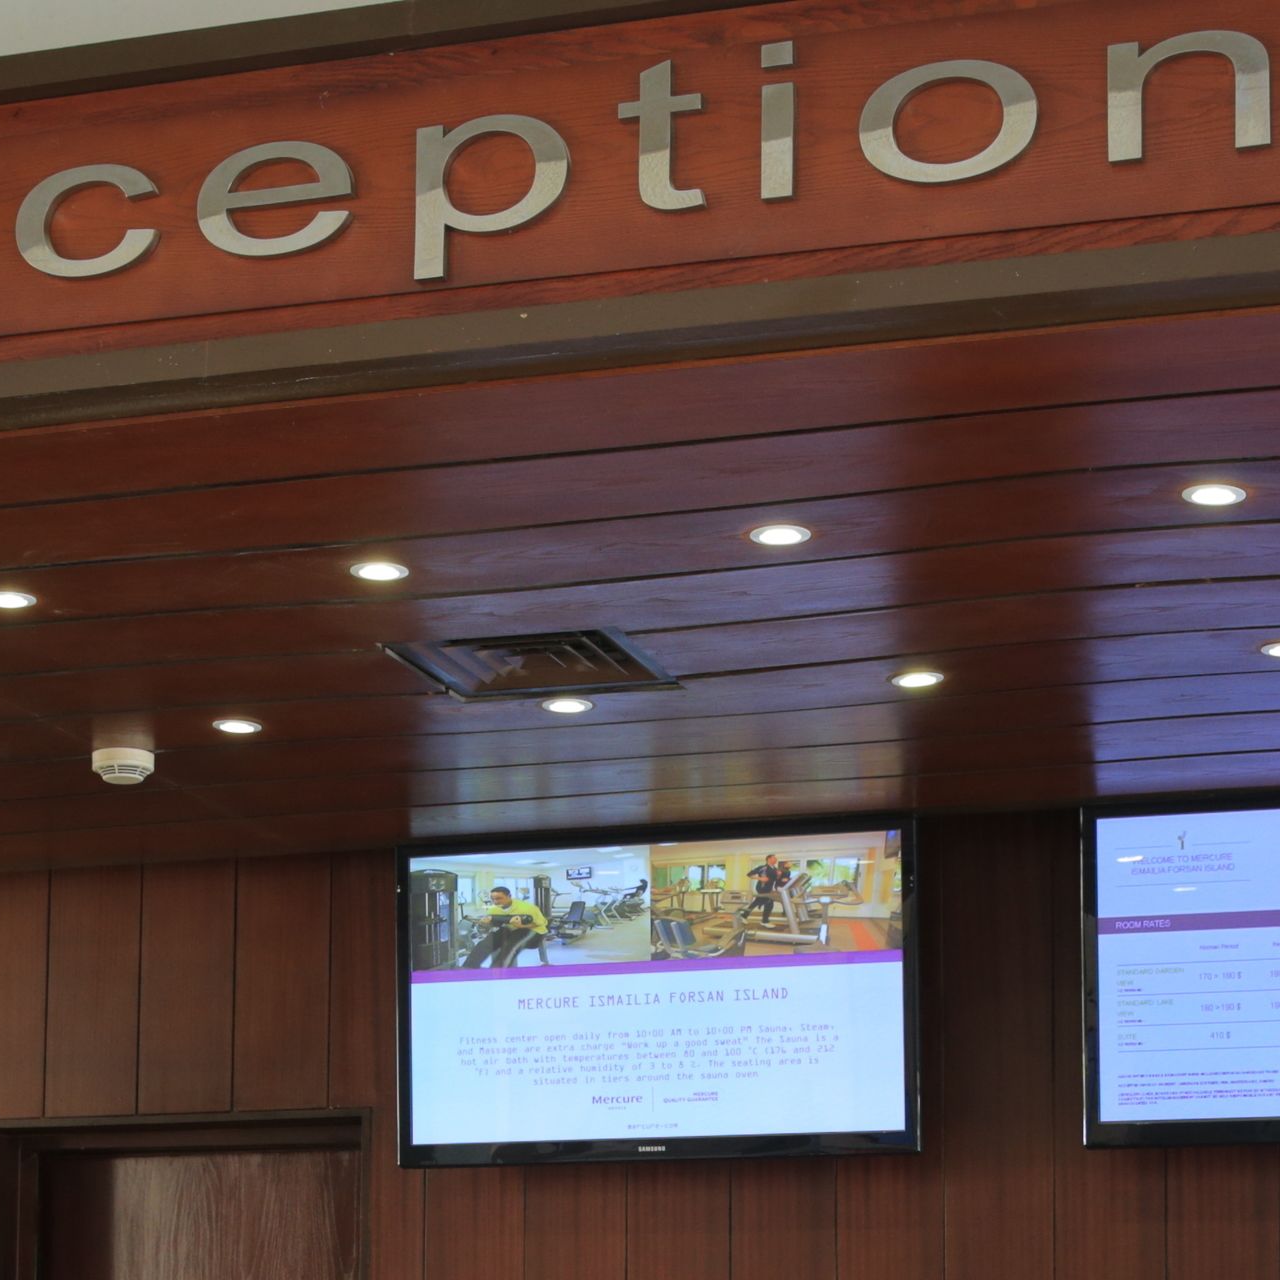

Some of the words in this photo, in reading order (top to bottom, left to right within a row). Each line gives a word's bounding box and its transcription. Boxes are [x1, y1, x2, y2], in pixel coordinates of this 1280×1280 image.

[1178, 855, 1189, 863] TO
[1190, 853, 1232, 862] MERCURE
[1131, 867, 1165, 876] ISMAILIA
[1167, 864, 1202, 874] FORSAN
[1204, 863, 1236, 872] ISLAND
[1115, 920, 1142, 930] ROOM
[1143, 919, 1171, 928] RATES
[518, 996, 580, 1010] MERCURE
[589, 993, 661, 1008] ISMAILIA
[669, 990, 724, 1004] FORSAN
[734, 987, 789, 1001] ISLAND
[459, 1036, 498, 1045] Fitness
[505, 1034, 537, 1043] center
[544, 1034, 566, 1044] open
[572, 1032, 600, 1043] daily
[608, 1031, 630, 1039] from
[670, 1028, 682, 1036] AM
[688, 1028, 700, 1036] to
[740, 1026, 752, 1034] PM
[457, 1048, 474, 1056] and
[479, 1046, 518, 1056] Massage
[524, 1046, 541, 1054] are
[546, 1044, 575, 1052] extra
[580, 1042, 615, 1052] charge
[656, 1041, 668, 1050] up
[685, 1038, 708, 1048] good
[756, 1036, 772, 1044] The
[779, 1034, 808, 1043] Sauna
[815, 1033, 827, 1042] is
[460, 1058, 476, 1066] hot
[483, 1056, 498, 1066] air
[506, 1056, 528, 1064] bath
[534, 1054, 557, 1063] with
[562, 1052, 629, 1063] temperatures
[636, 1050, 676, 1060] between
[701, 1048, 718, 1057] and
[725, 1047, 742, 1056] 100
[792, 1044, 810, 1054] and
[496, 1068, 512, 1076] and
[529, 1065, 574, 1074] relative
[580, 1063, 624, 1074] humidity
[632, 1062, 642, 1070] of
[661, 1060, 672, 1069] to
[708, 1058, 724, 1068] The
[731, 1057, 772, 1068] seating
[778, 1057, 802, 1066] area
[808, 1056, 819, 1065] is
[533, 1076, 578, 1086] situated
[585, 1076, 596, 1084] in
[602, 1074, 630, 1084] tiers
[636, 1073, 670, 1082] around
[677, 1072, 694, 1081] the
[700, 1072, 728, 1080] sauna
[736, 1070, 759, 1079] oven
[592, 1094, 643, 1105] Mercure
